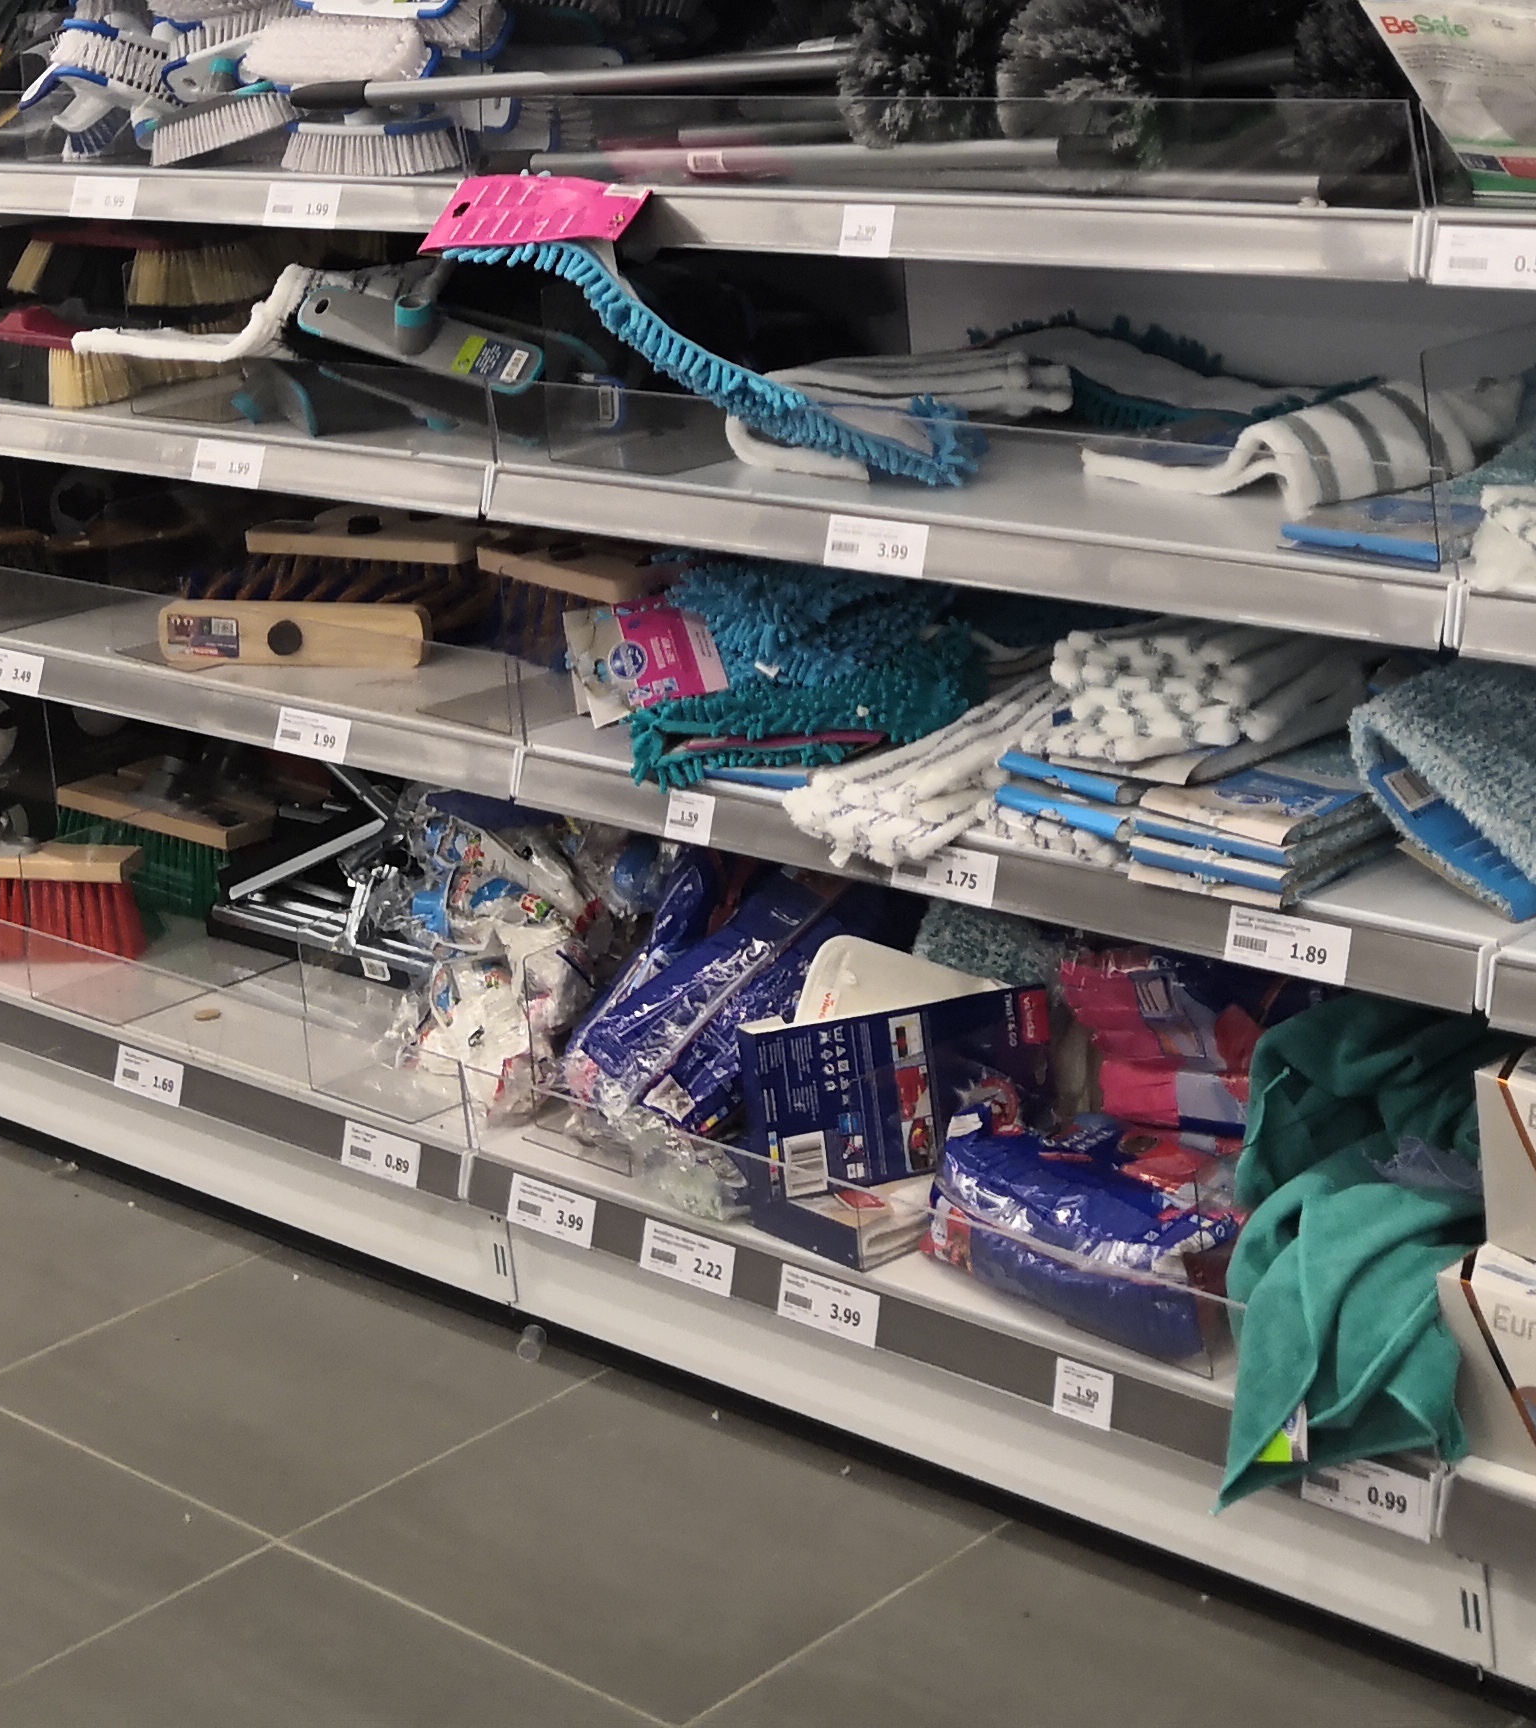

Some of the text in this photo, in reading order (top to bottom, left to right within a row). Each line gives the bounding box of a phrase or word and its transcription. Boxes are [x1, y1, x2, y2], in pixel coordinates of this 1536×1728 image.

[1379, 13, 1470, 40] BeSafe
[305, 203, 330, 217] 1.99
[226, 460, 251, 476] 1.99
[877, 542, 909, 562] 3.99
[12, 667, 32, 683] 3.49
[312, 731, 337, 748] 1.99
[946, 869, 978, 891] 1.75
[1290, 943, 1327, 964] 1.89
[152, 1076, 175, 1094] 1.69
[385, 1153, 410, 1174] 0.89
[556, 1210, 584, 1231] 3.99
[693, 1258, 723, 1280] 2.22
[830, 1303, 861, 1327] 3.99
[1367, 1490, 1408, 1515] 0.99
